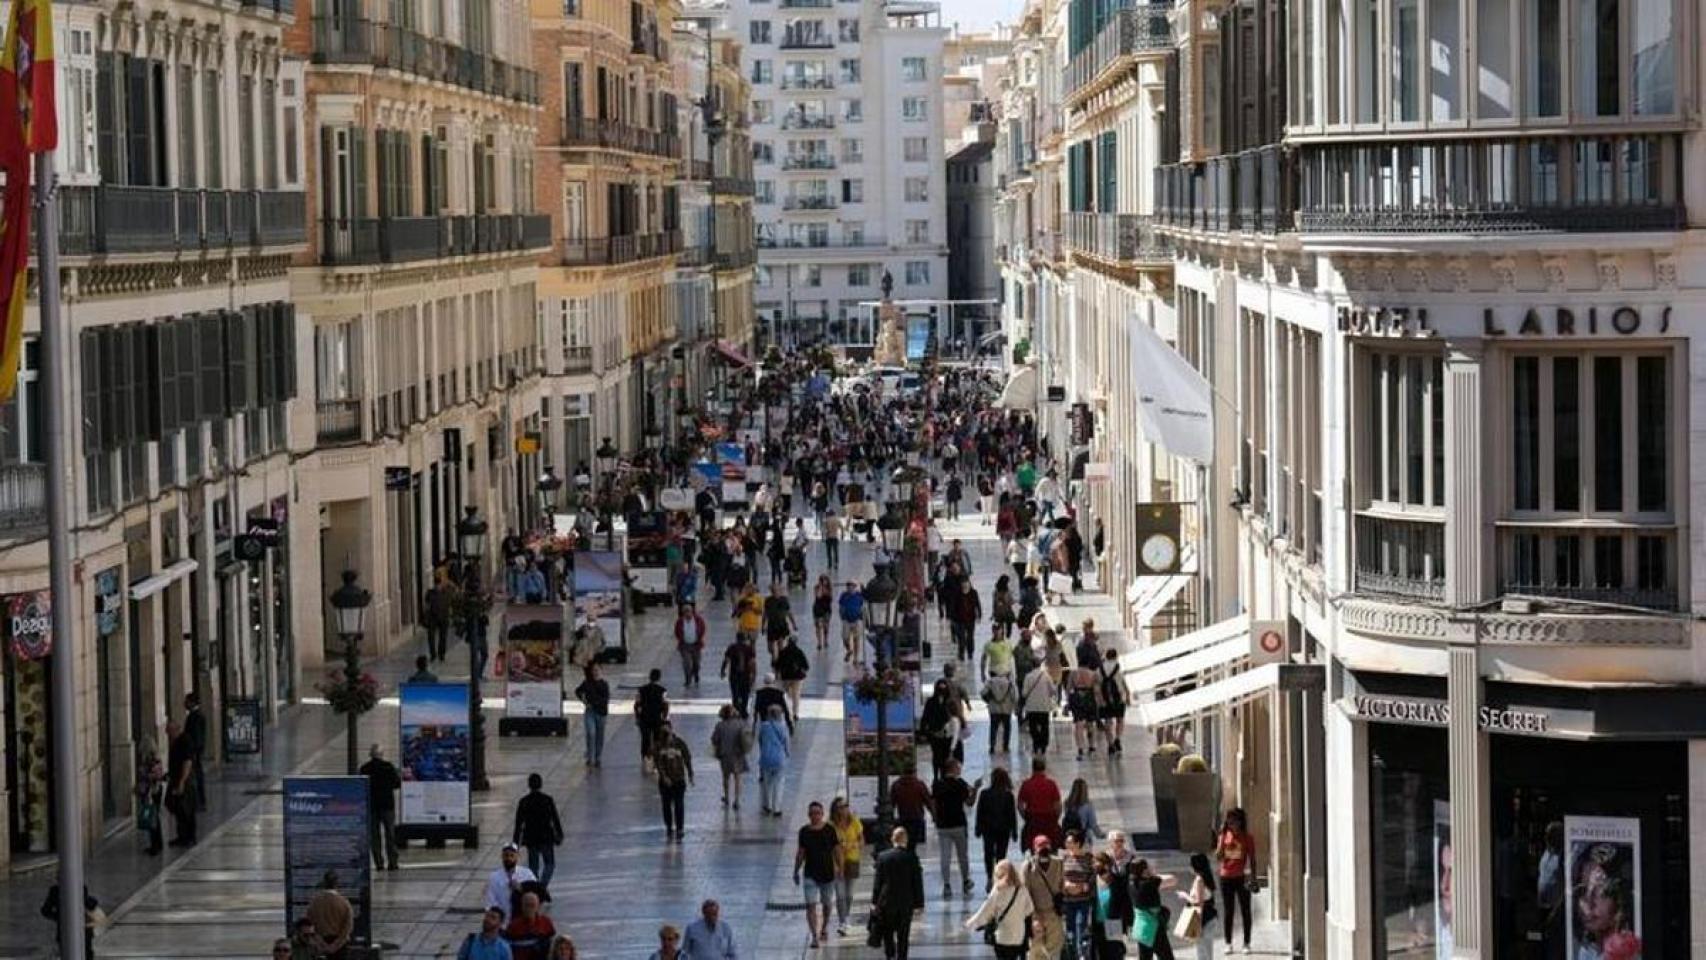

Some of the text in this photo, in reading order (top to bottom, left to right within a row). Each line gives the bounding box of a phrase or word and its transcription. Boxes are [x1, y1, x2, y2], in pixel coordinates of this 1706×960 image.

[1483, 306, 1672, 335] LARIOS
[1354, 696, 1547, 732] VICTORIA'S SECRET
